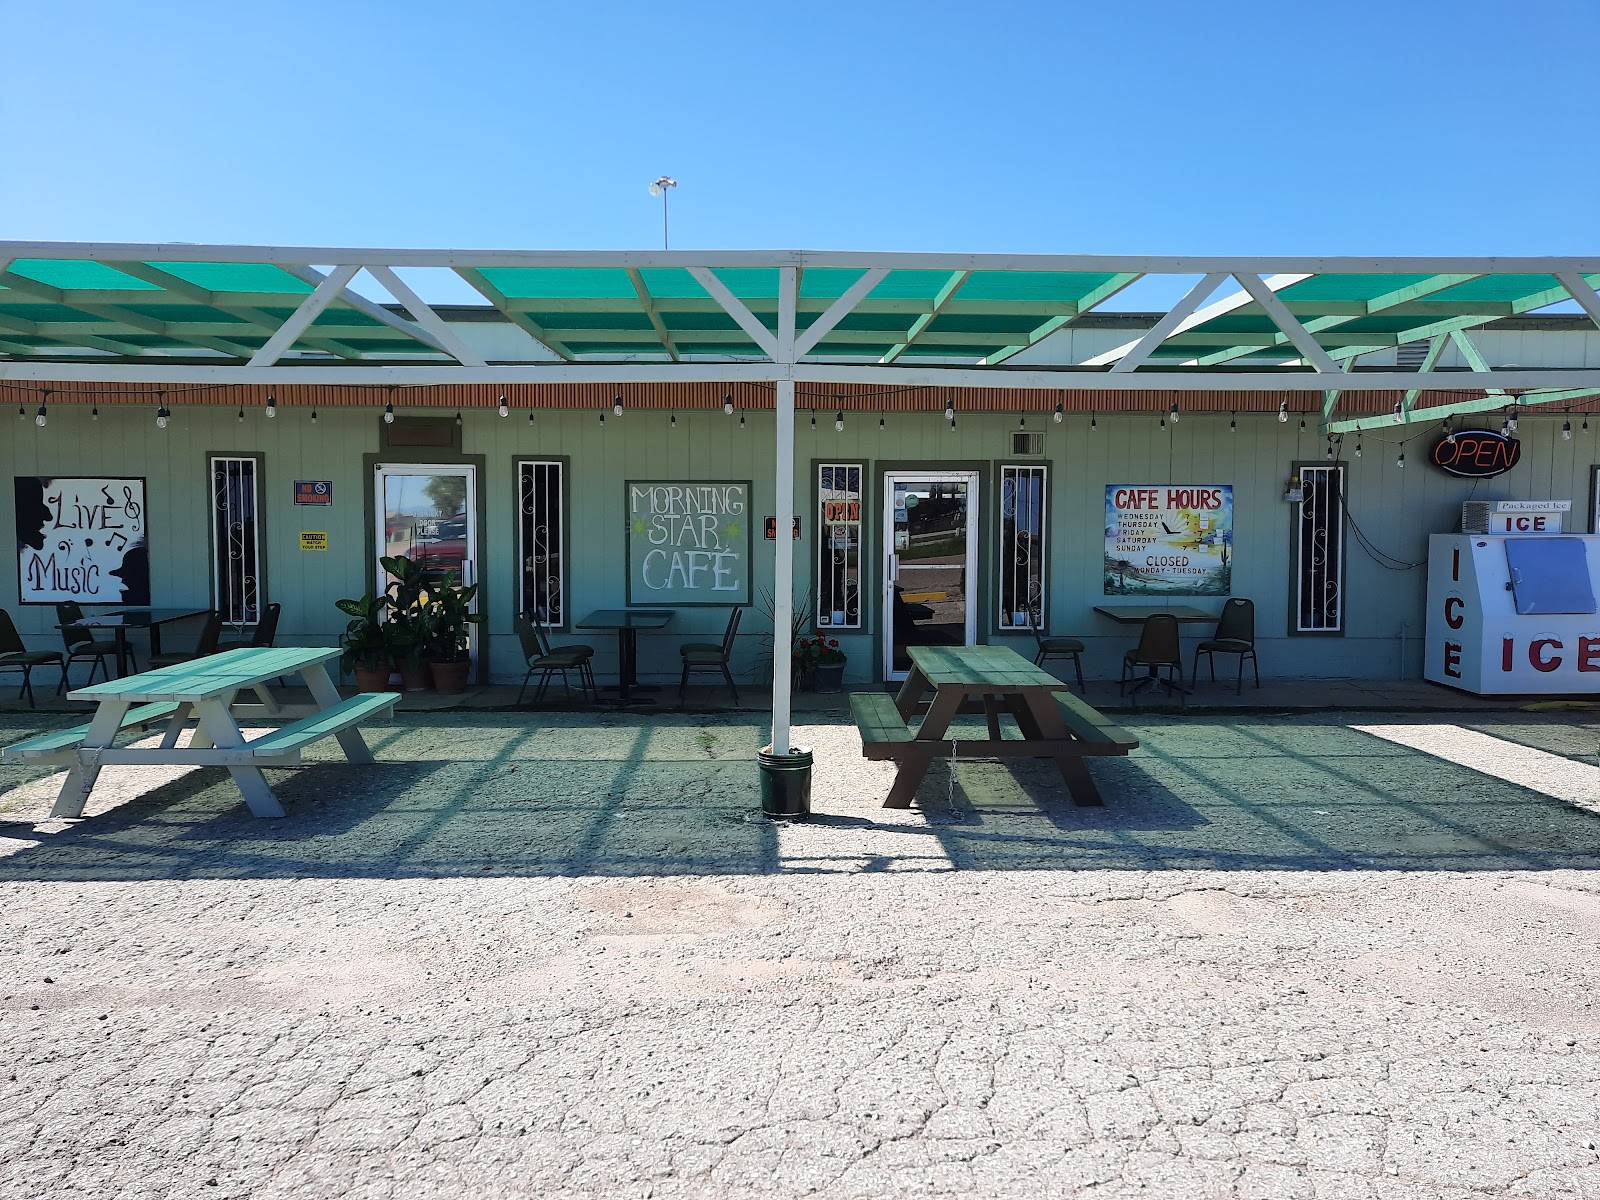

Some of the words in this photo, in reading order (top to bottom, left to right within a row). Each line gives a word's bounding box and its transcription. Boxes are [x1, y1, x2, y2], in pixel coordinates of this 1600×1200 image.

[1434, 439, 1517, 467] OPEN
[297, 494, 330, 502] SMOKING
[301, 484, 312, 492] NO
[631, 486, 744, 515] MORNING
[1115, 489, 1158, 509] CAFE
[1166, 489, 1222, 510] HOURS
[48, 490, 124, 530] LivE
[826, 503, 859, 521] OPEN
[1502, 502, 1550, 510] Packaged
[648, 514, 722, 549] STAR
[1506, 516, 1546, 531] ICE
[27, 553, 100, 594] Music
[642, 546, 740, 591] CAFÉ
[1146, 555, 1189, 567] CLOSED
[1444, 543, 1465, 679] ICE
[1502, 632, 1600, 673] ICE
